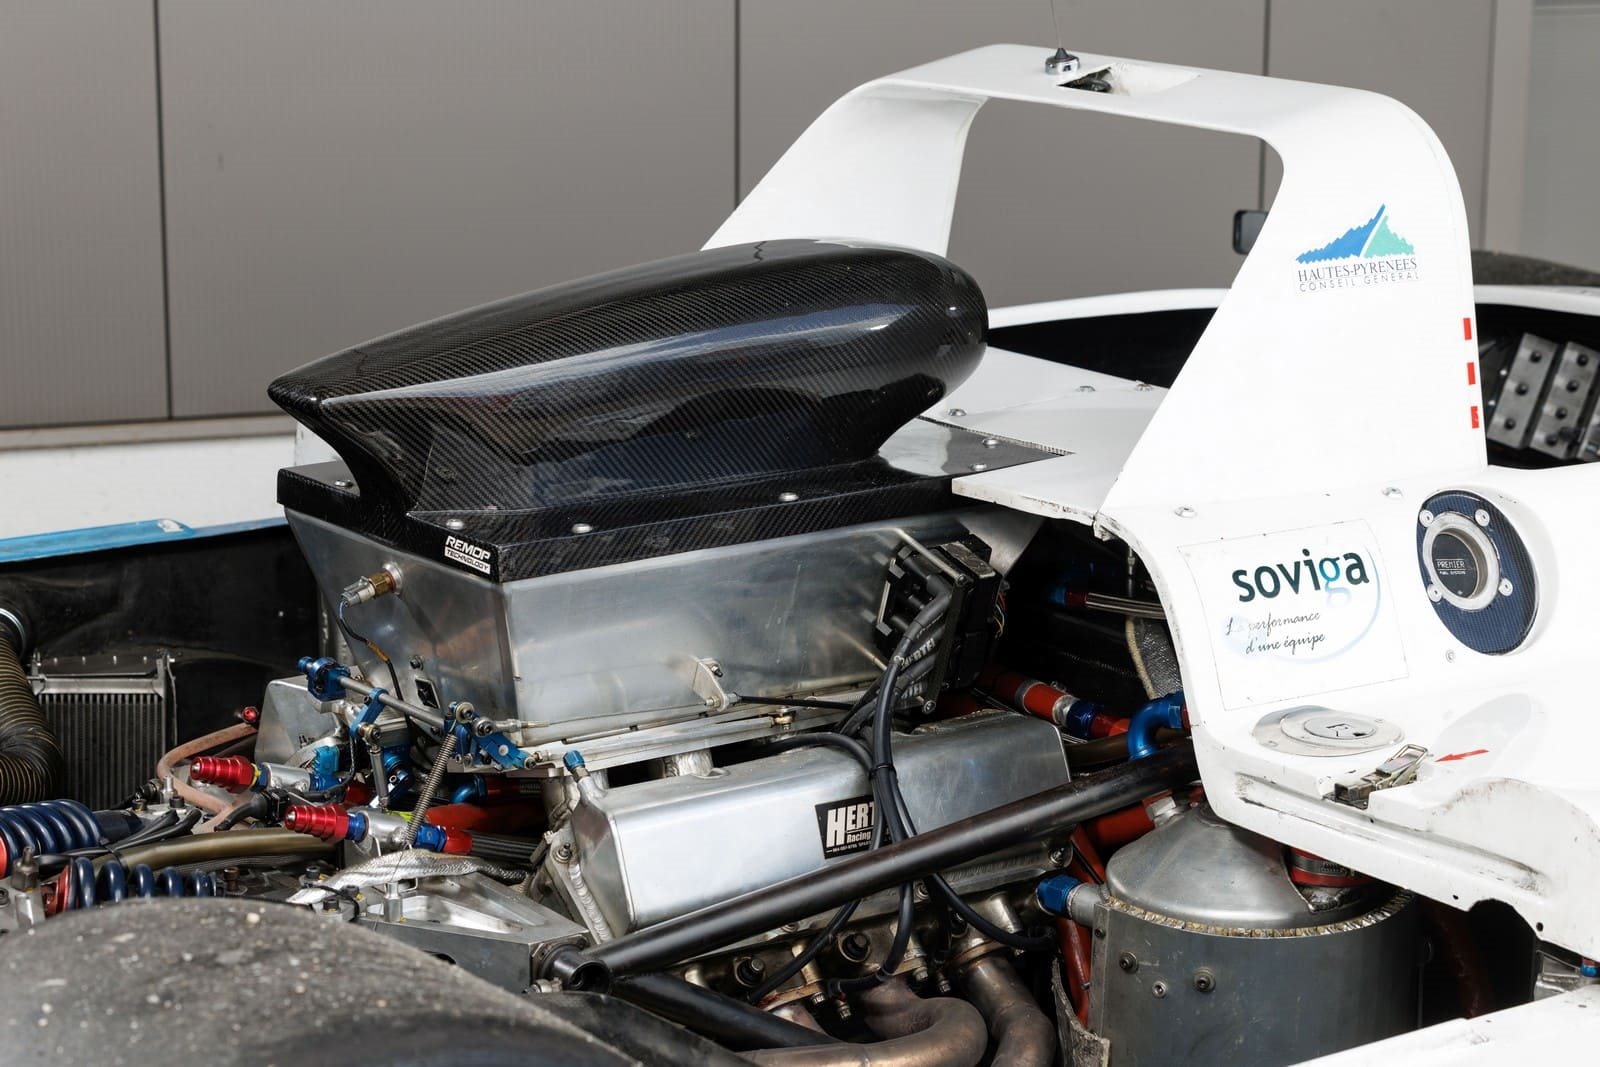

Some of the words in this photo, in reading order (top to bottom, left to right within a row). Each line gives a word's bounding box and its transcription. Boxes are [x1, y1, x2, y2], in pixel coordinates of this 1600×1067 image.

[1298, 257, 1418, 282] HAUTES-PYRENEES
[1299, 277, 1356, 292] CONSEIL
[1363, 271, 1419, 285] GENERAL
[445, 535, 491, 560] REMOP
[446, 548, 489, 571] TECHNOLOGY
[1231, 548, 1370, 606] soviga
[1247, 612, 1321, 638] performance
[1245, 637, 1281, 654] d'une
[1284, 632, 1326, 655] équipe
[826, 801, 875, 848] HERT
[846, 831, 872, 844] Racing
